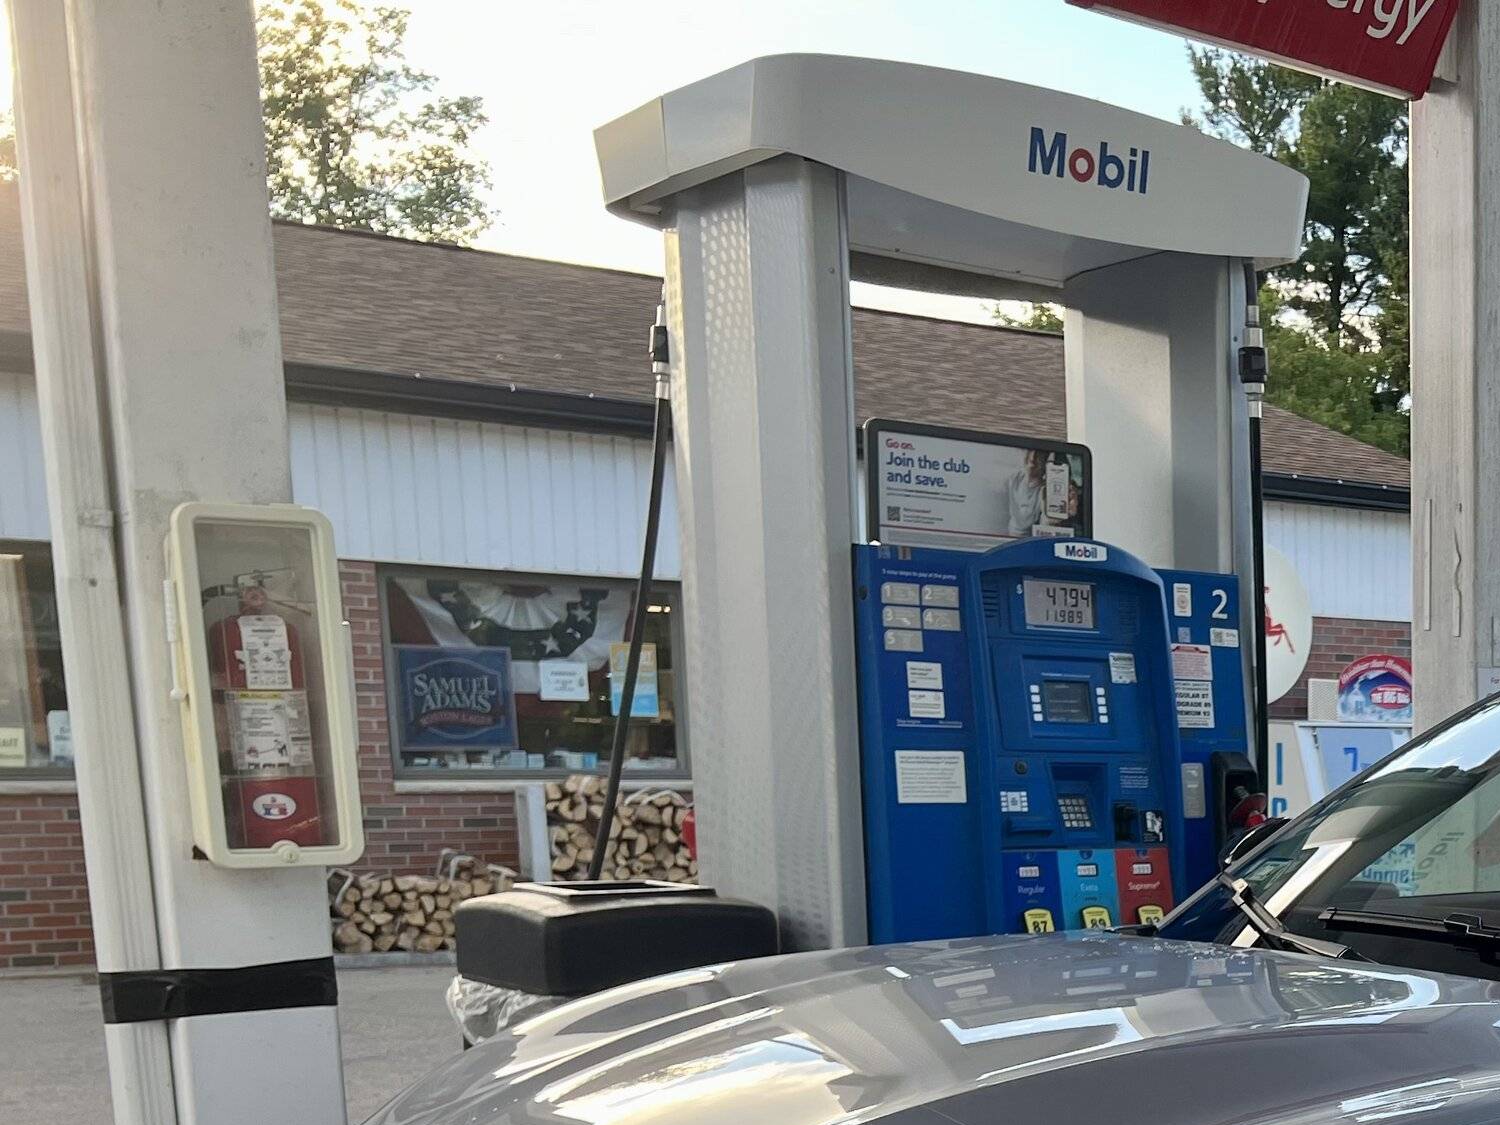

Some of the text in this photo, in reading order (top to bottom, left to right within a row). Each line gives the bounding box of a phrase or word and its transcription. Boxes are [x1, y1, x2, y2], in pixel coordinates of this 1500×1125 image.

[1028, 126, 1150, 194] Mobil
[885, 438, 899, 449] Go
[886, 452, 970, 474] Join the club
[886, 471, 948, 488] and save.
[1065, 545, 1098, 559] Mobil
[884, 585, 892, 597] 1
[925, 588, 933, 600] 2
[1211, 589, 1229, 620] 2
[886, 609, 894, 621] 3
[414, 673, 497, 697] SAMUEL
[421, 690, 492, 714] ADAMS
[1343, 747, 1358, 772] 7
[1018, 885, 1046, 895] Regular
[1032, 920, 1048, 933] 87
